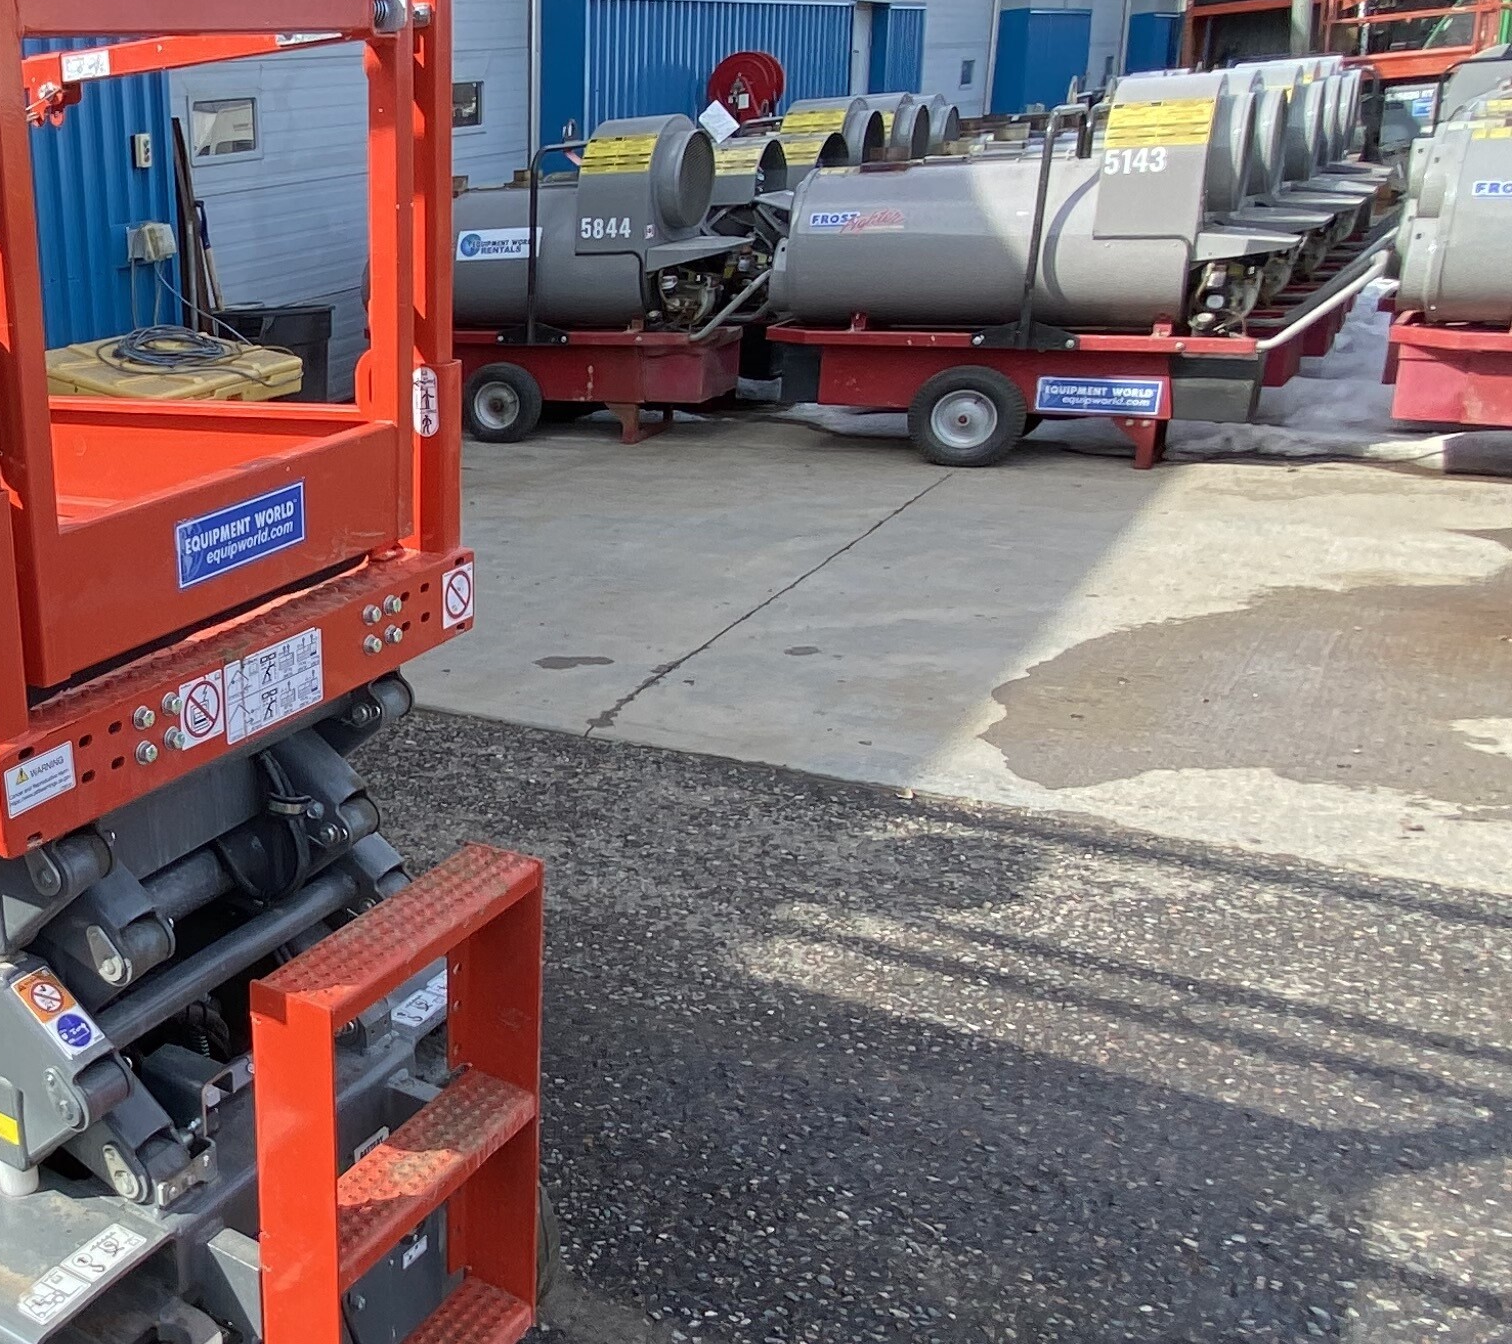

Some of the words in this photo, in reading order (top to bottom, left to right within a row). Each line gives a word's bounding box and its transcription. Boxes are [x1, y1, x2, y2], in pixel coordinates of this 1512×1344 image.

[1104, 146, 1167, 175] 5143
[580, 217, 631, 239] 5844
[811, 213, 858, 226] FROST
[481, 245, 522, 255] RENTALS
[1044, 384, 1108, 397] EQUIPMENT
[1112, 387, 1154, 399] WORLD
[1061, 396, 1150, 407] equipworld.com
[185, 516, 251, 555] EQUIPMENT
[254, 500, 295, 529] WORLD
[206, 520, 294, 564] equipworld.com
